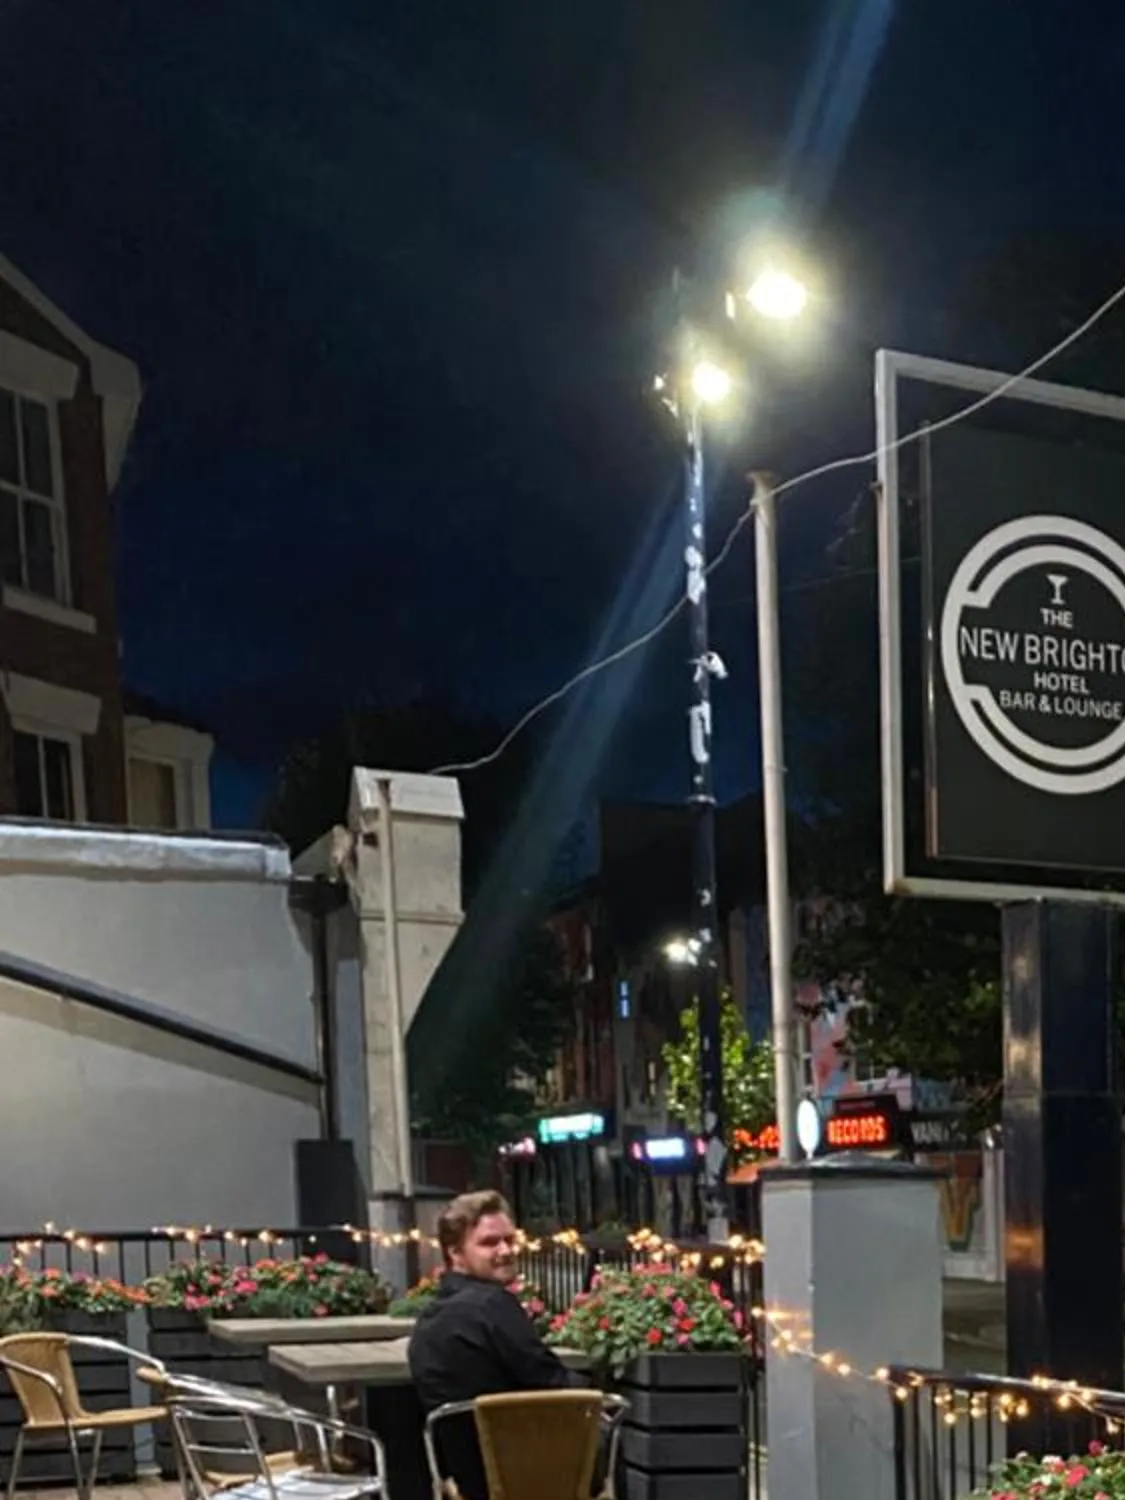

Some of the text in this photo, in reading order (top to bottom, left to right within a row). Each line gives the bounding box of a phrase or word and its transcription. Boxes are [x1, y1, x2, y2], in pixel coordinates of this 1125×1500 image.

[1040, 607, 1073, 629] THE
[959, 625, 1018, 663] NEW
[1034, 671, 1089, 694] HOTEL
[1000, 689, 1122, 719] BAR & LOUNGE
